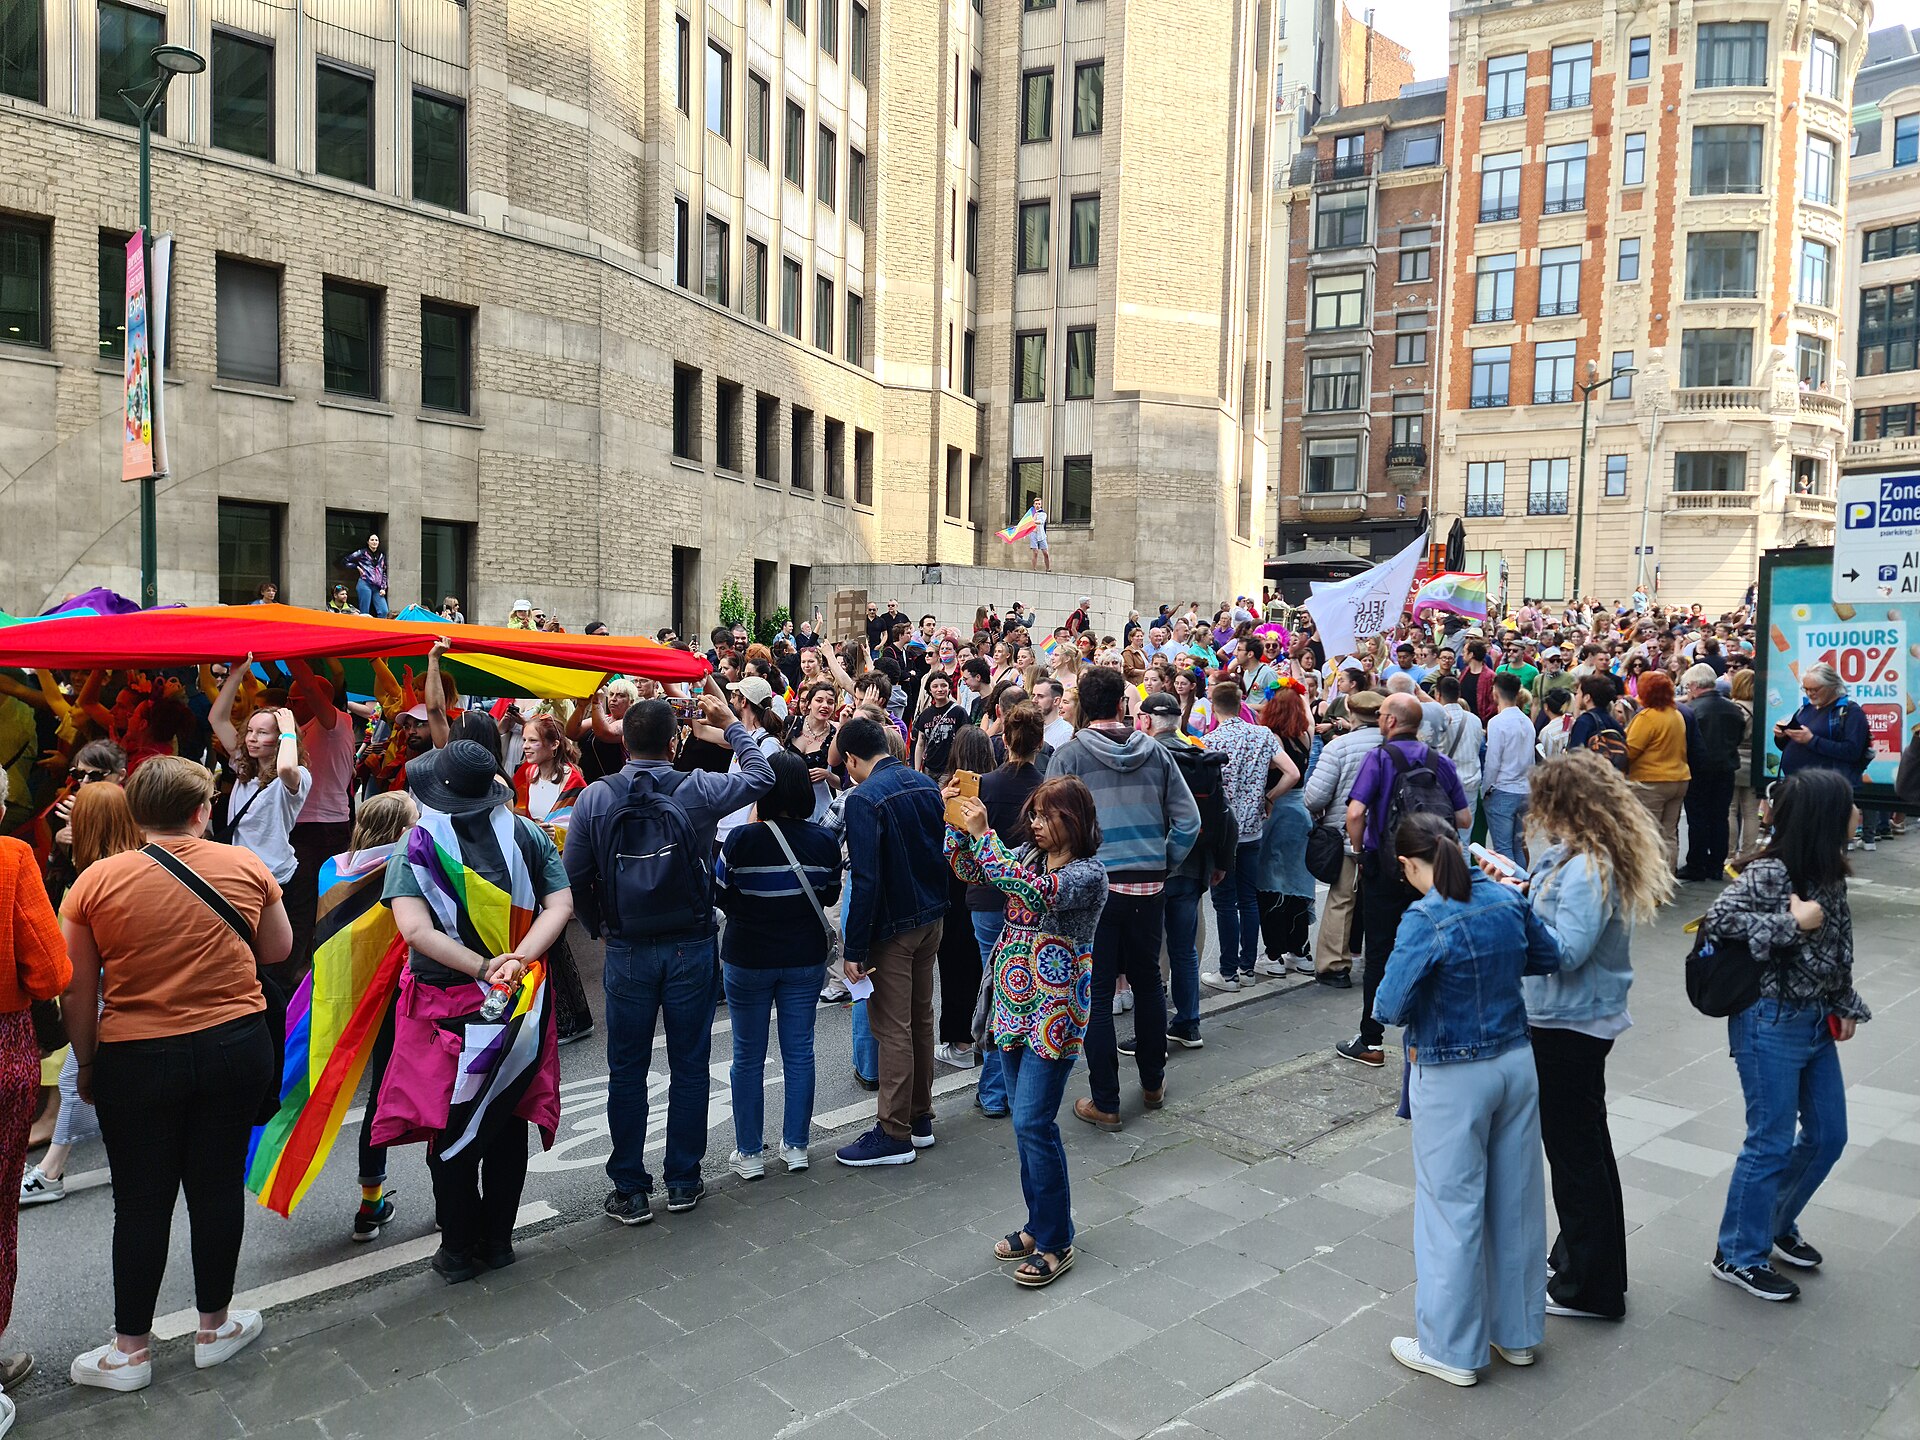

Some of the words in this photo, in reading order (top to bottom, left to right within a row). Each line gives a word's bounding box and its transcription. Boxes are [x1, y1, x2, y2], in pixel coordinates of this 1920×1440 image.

[1881, 482, 1920, 501] Zone
[1880, 503, 1920, 522] Zone
[1806, 629, 1899, 647] TOUJOURS
[1818, 647, 1899, 683] 10%
[1856, 684, 1898, 698] FRAIS
